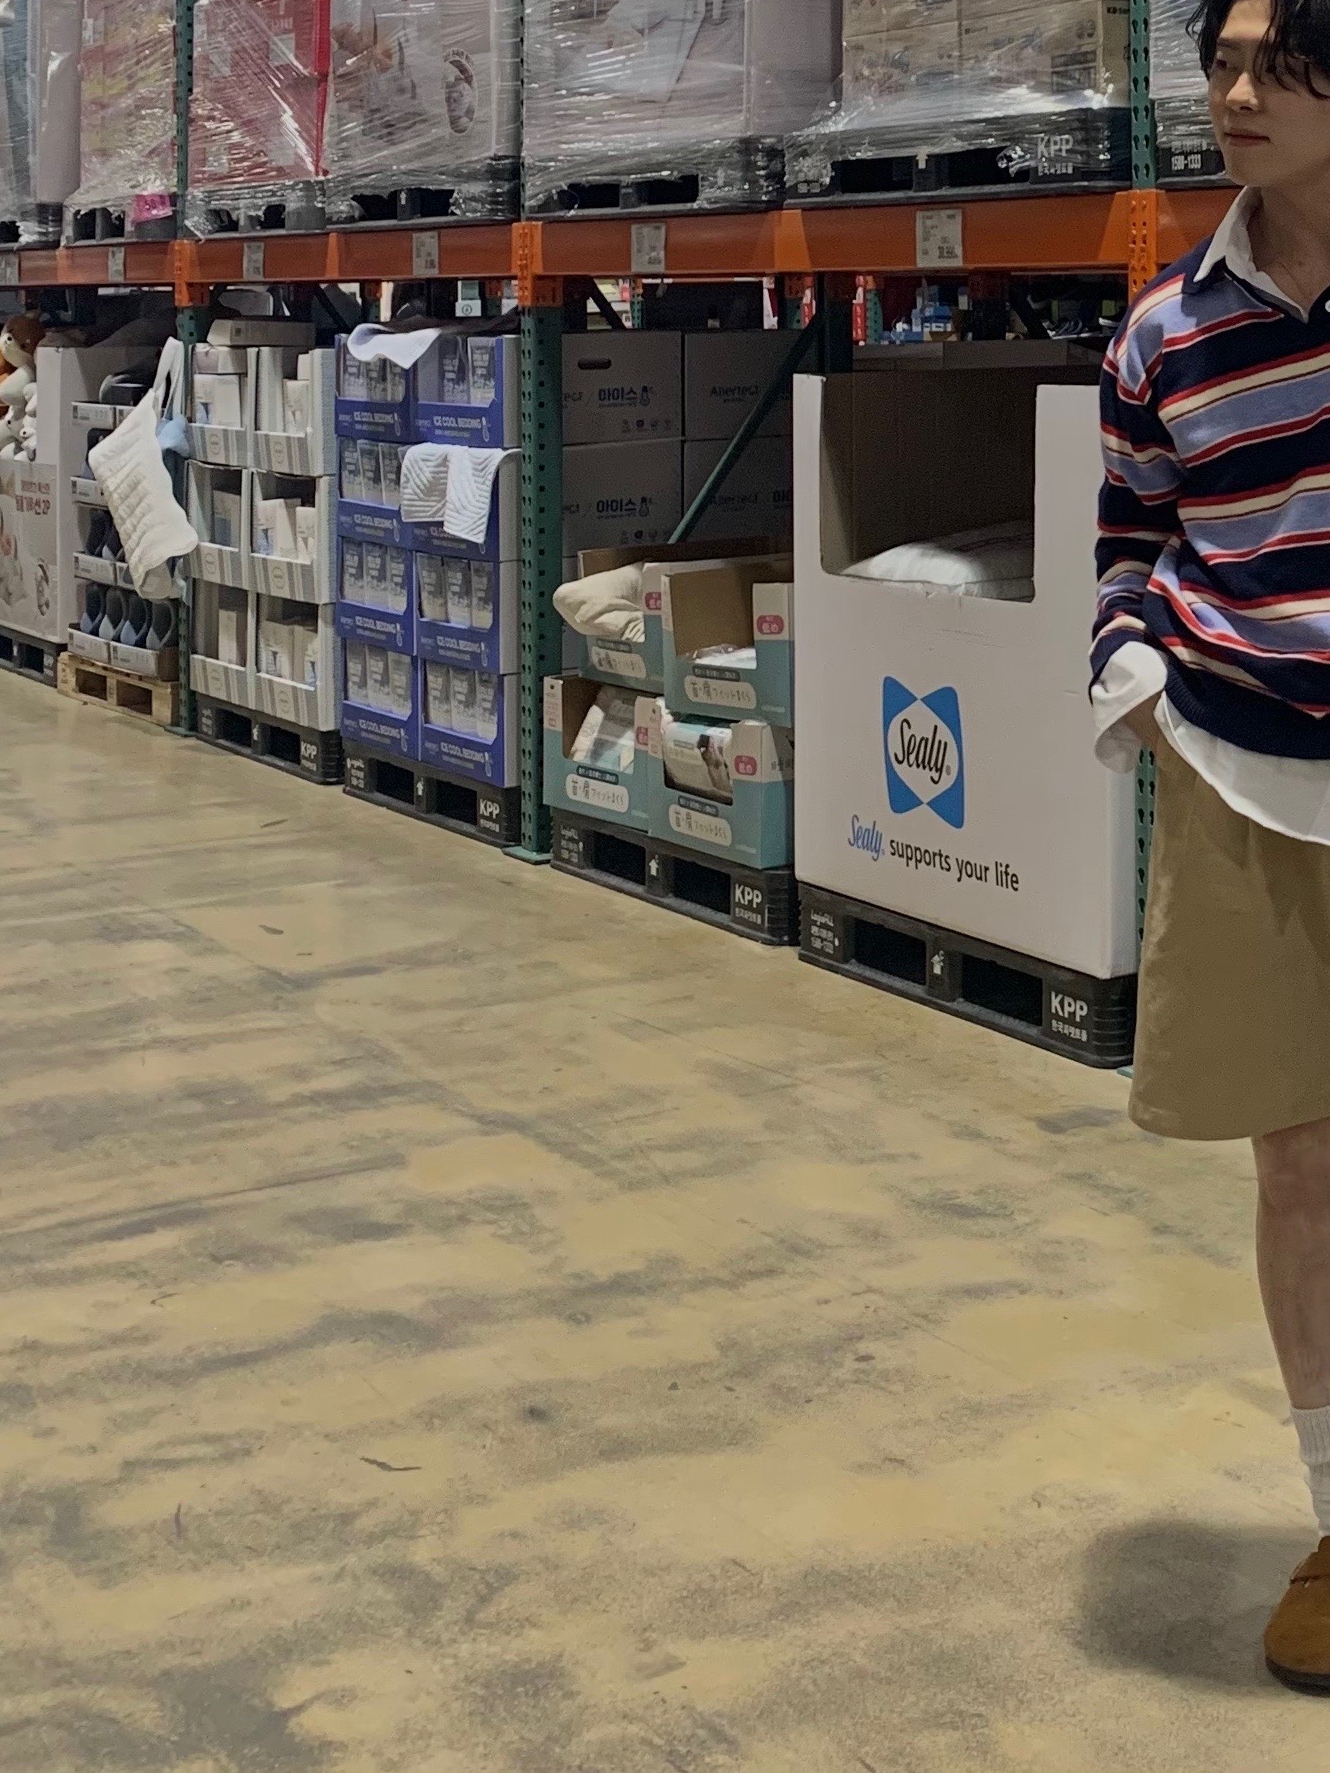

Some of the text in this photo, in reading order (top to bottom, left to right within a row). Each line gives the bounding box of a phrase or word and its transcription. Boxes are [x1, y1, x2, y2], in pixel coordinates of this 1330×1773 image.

[1037, 134, 1074, 159] KPP
[598, 386, 639, 403] 아이스
[596, 498, 638, 515] 아이스
[301, 740, 318, 760] KPP
[894, 718, 949, 785] Sealy
[479, 798, 500, 820] KPP
[847, 813, 1020, 892] Sealy supports your life
[734, 882, 763, 909] KPP
[1050, 990, 1089, 1023] KPP
